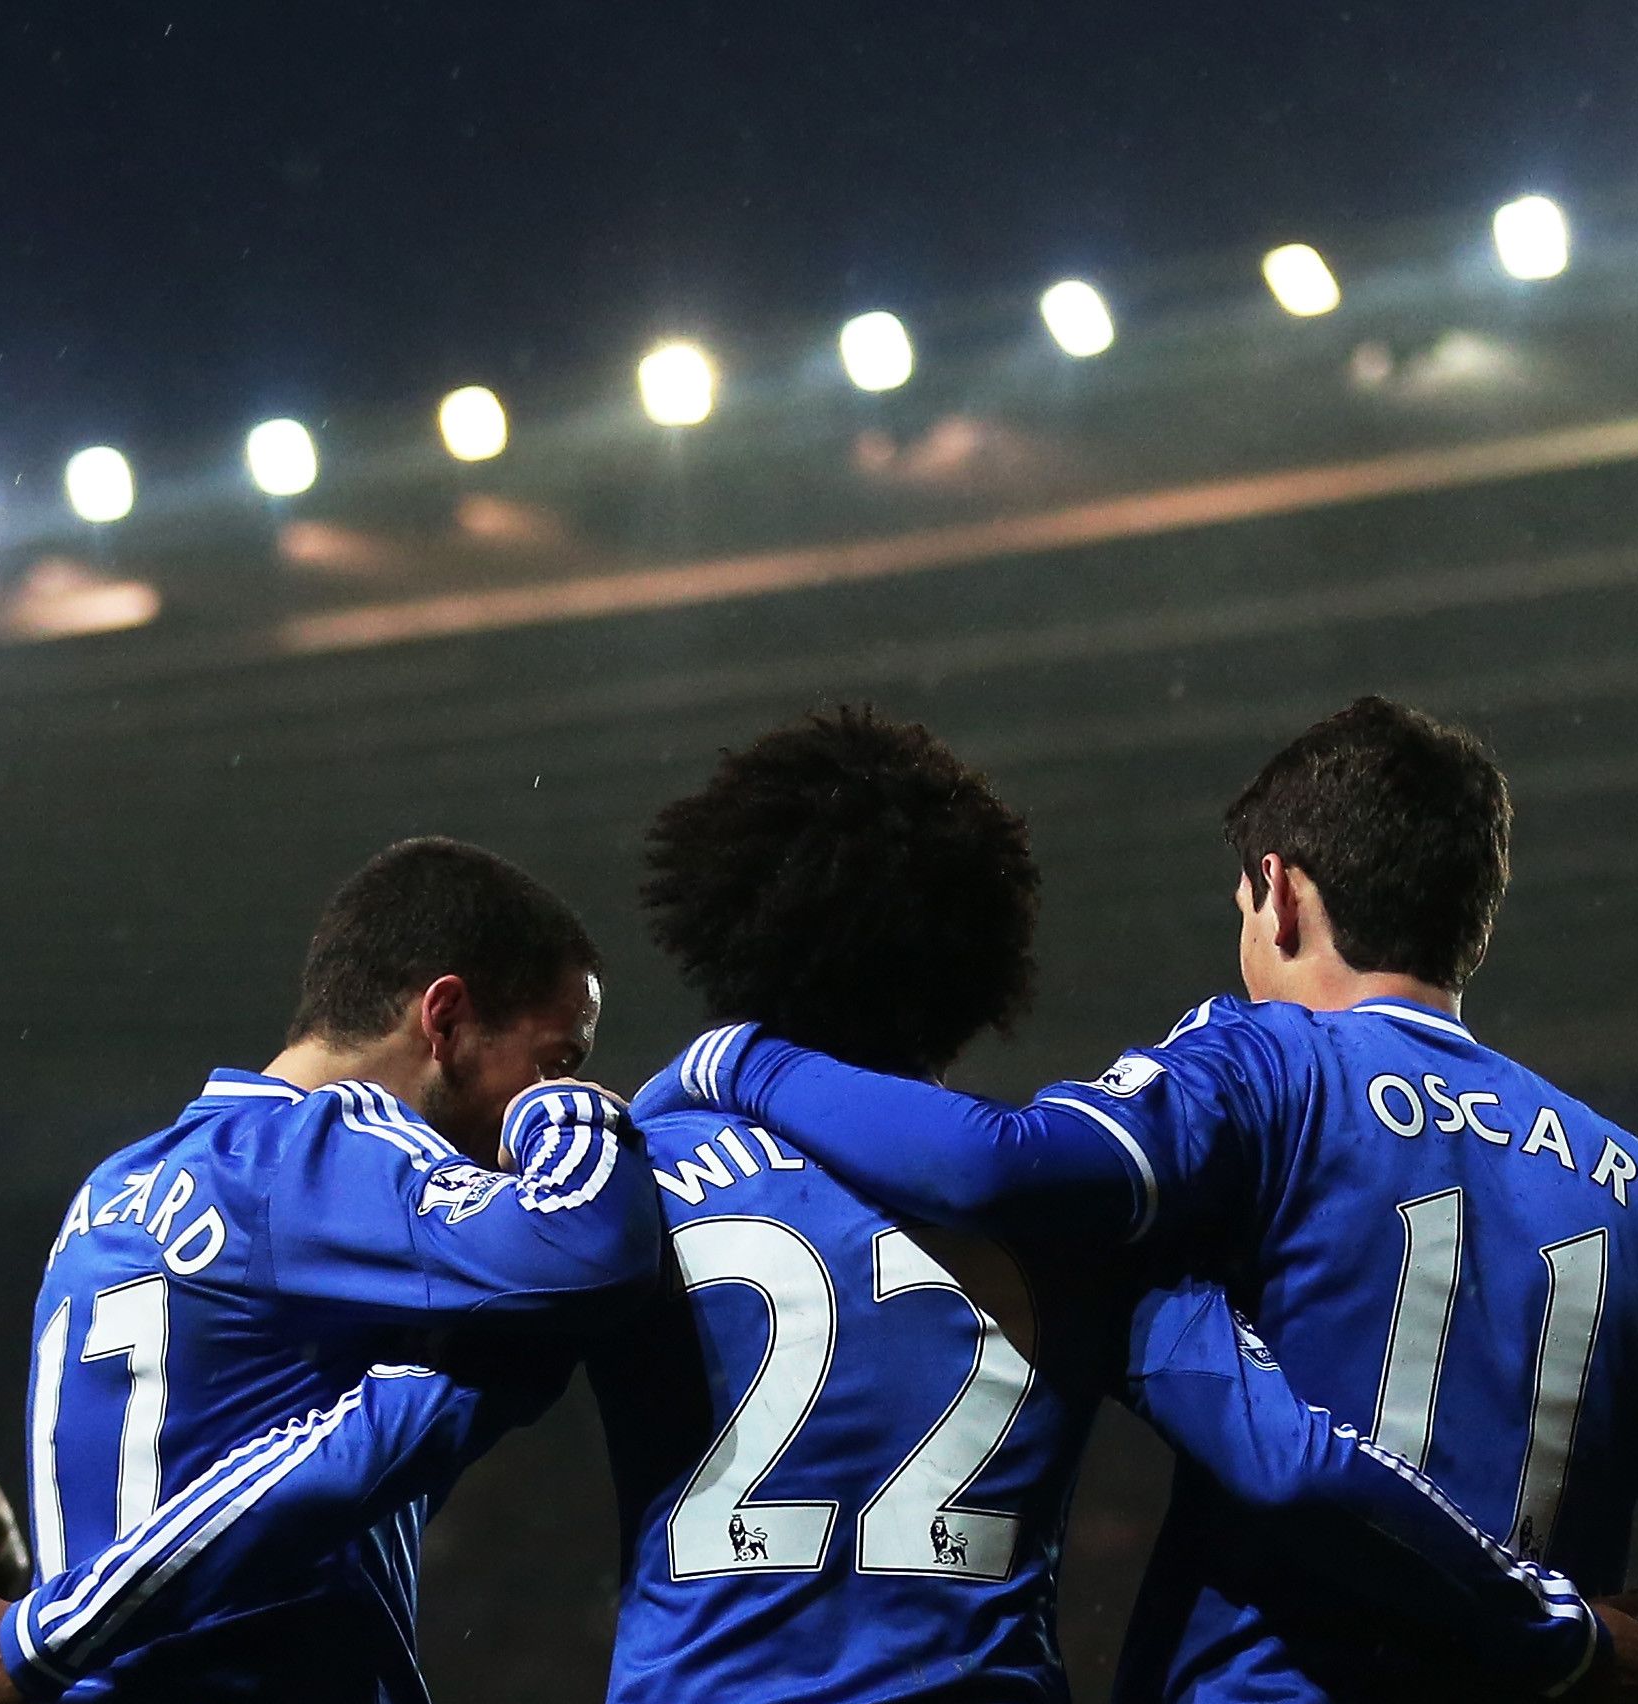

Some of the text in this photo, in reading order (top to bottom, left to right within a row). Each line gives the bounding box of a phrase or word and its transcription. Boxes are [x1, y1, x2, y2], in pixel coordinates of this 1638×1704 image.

[33, 1271, 169, 1585] 17
[668, 1213, 1040, 1583] 22
[1365, 1186, 1609, 1566] 11
